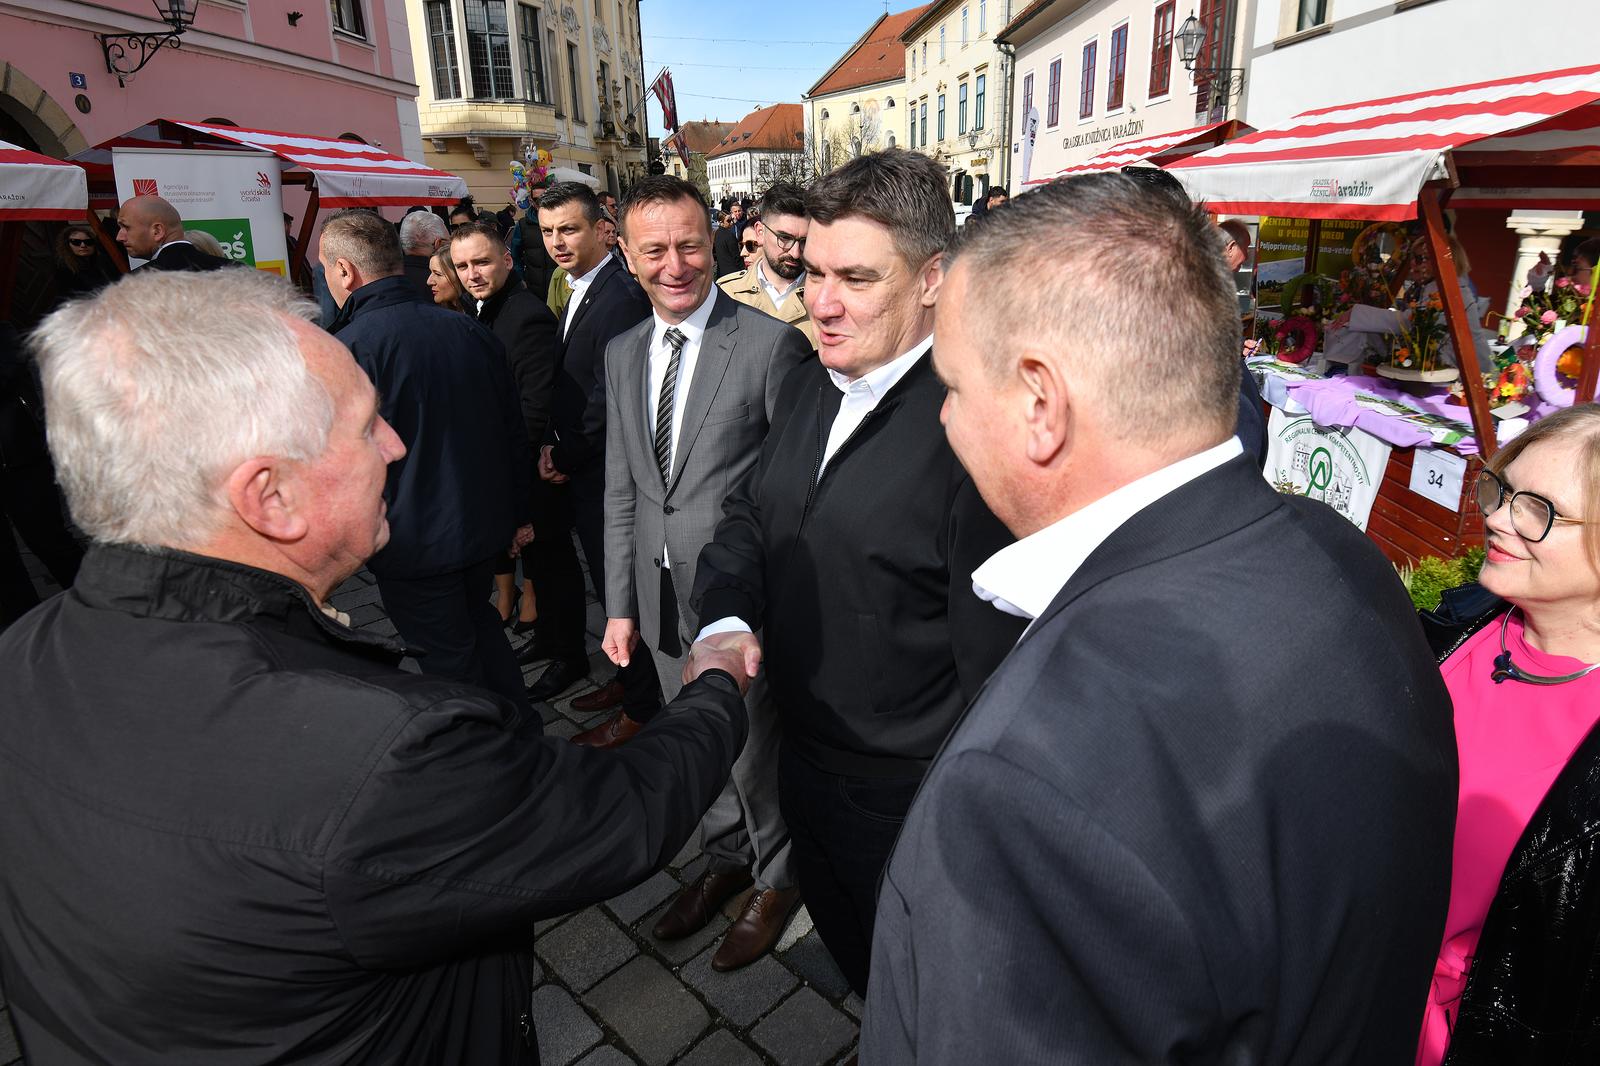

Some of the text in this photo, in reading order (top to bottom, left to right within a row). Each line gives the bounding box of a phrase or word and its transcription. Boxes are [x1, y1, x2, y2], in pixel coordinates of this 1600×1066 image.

[74, 75, 82, 86] 3
[1062, 119, 1144, 149] GRADSKA KNJIŽNICA VARAŽDIN
[1278, 229, 1283, 237] U
[1428, 469, 1444, 488] 34
